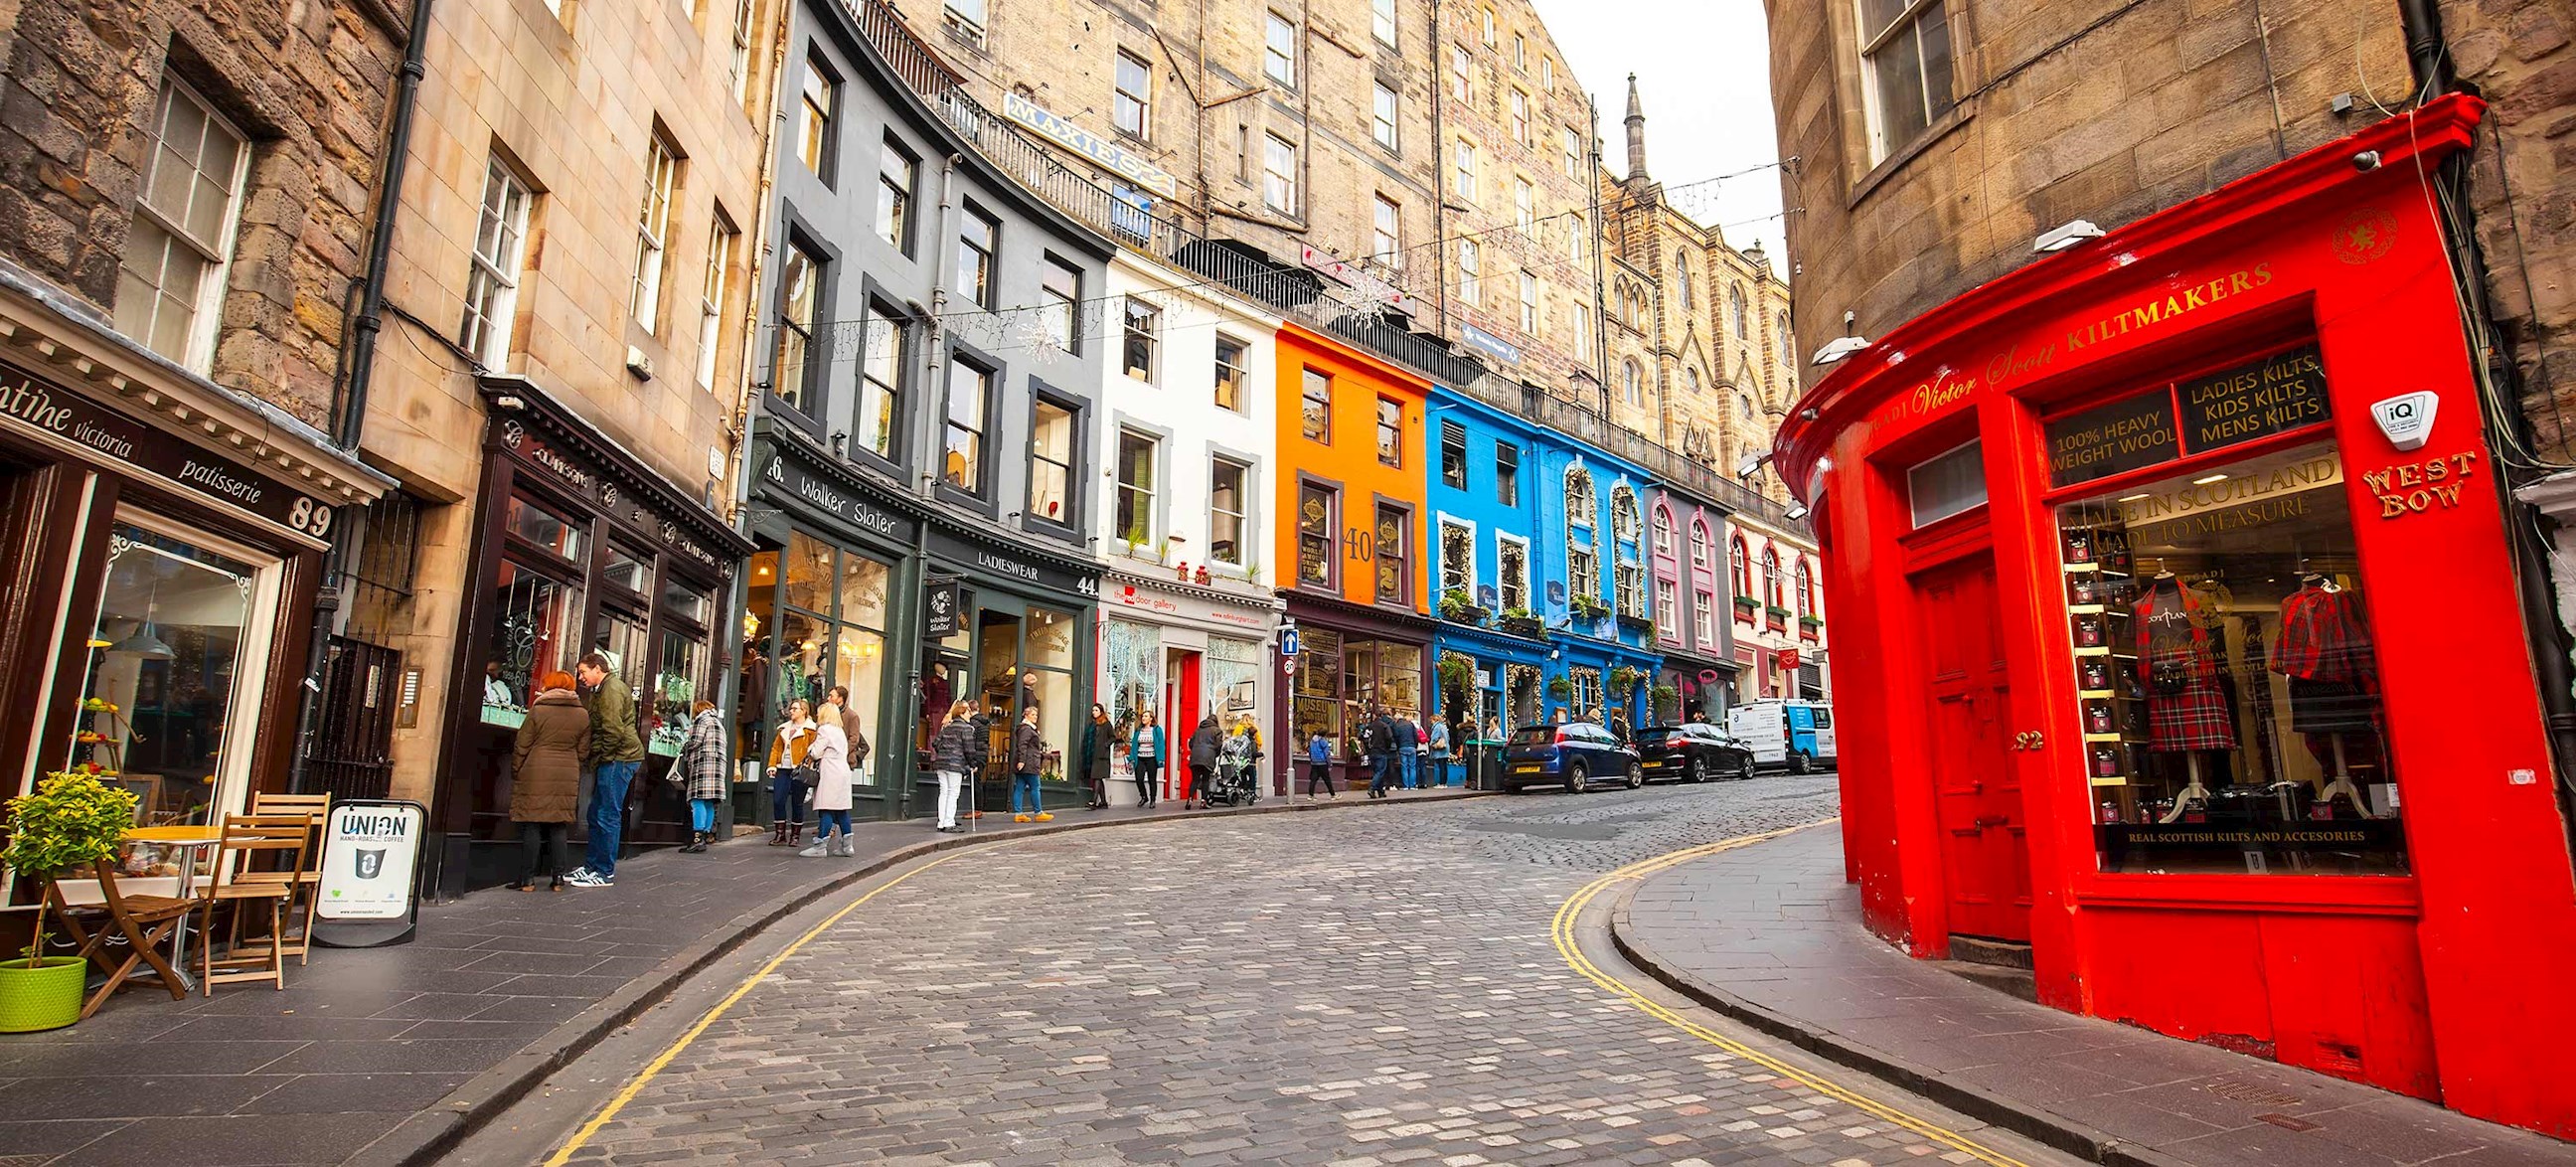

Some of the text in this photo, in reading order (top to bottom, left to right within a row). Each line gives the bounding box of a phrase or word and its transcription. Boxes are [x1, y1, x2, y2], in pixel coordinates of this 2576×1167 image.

[2066, 260, 2274, 353] KILTMAKERS
[1912, 369, 1977, 416] Victor
[1986, 344, 2056, 393] Scott
[2190, 354, 2317, 406] LADIES KILTS
[2204, 379, 2308, 421] KIDS KILTS
[2056, 411, 2162, 453] 100% HEAVY
[2200, 398, 2321, 443] MENS KILTS
[2389, 403, 2413, 420] iQ
[2049, 427, 2177, 473] WEIGHT WOOL
[74, 419, 133, 459] victoria
[178, 457, 262, 505] patisserie
[288, 497, 332, 537] 89
[2362, 451, 2476, 495] WEST
[767, 456, 896, 535] 6. Walker Slater
[2065, 456, 2335, 535] MADE IN SCOTLAND
[2378, 479, 2464, 518] BOW
[2161, 521, 2190, 542] TO
[2195, 495, 2312, 535] MEASURE
[1344, 527, 1371, 563] 40
[978, 551, 1040, 582] LADIESWEAR
[1135, 594, 1151, 605] door
[1153, 597, 1177, 612] gallery
[515, 670, 527, 687] 60
[2217, 665, 2229, 675] IN
[2015, 731, 2044, 750] 92
[342, 815, 407, 836] UNION
[2129, 831, 2365, 843] REAL SCOTTISH KILTS AND ACCESORIES
